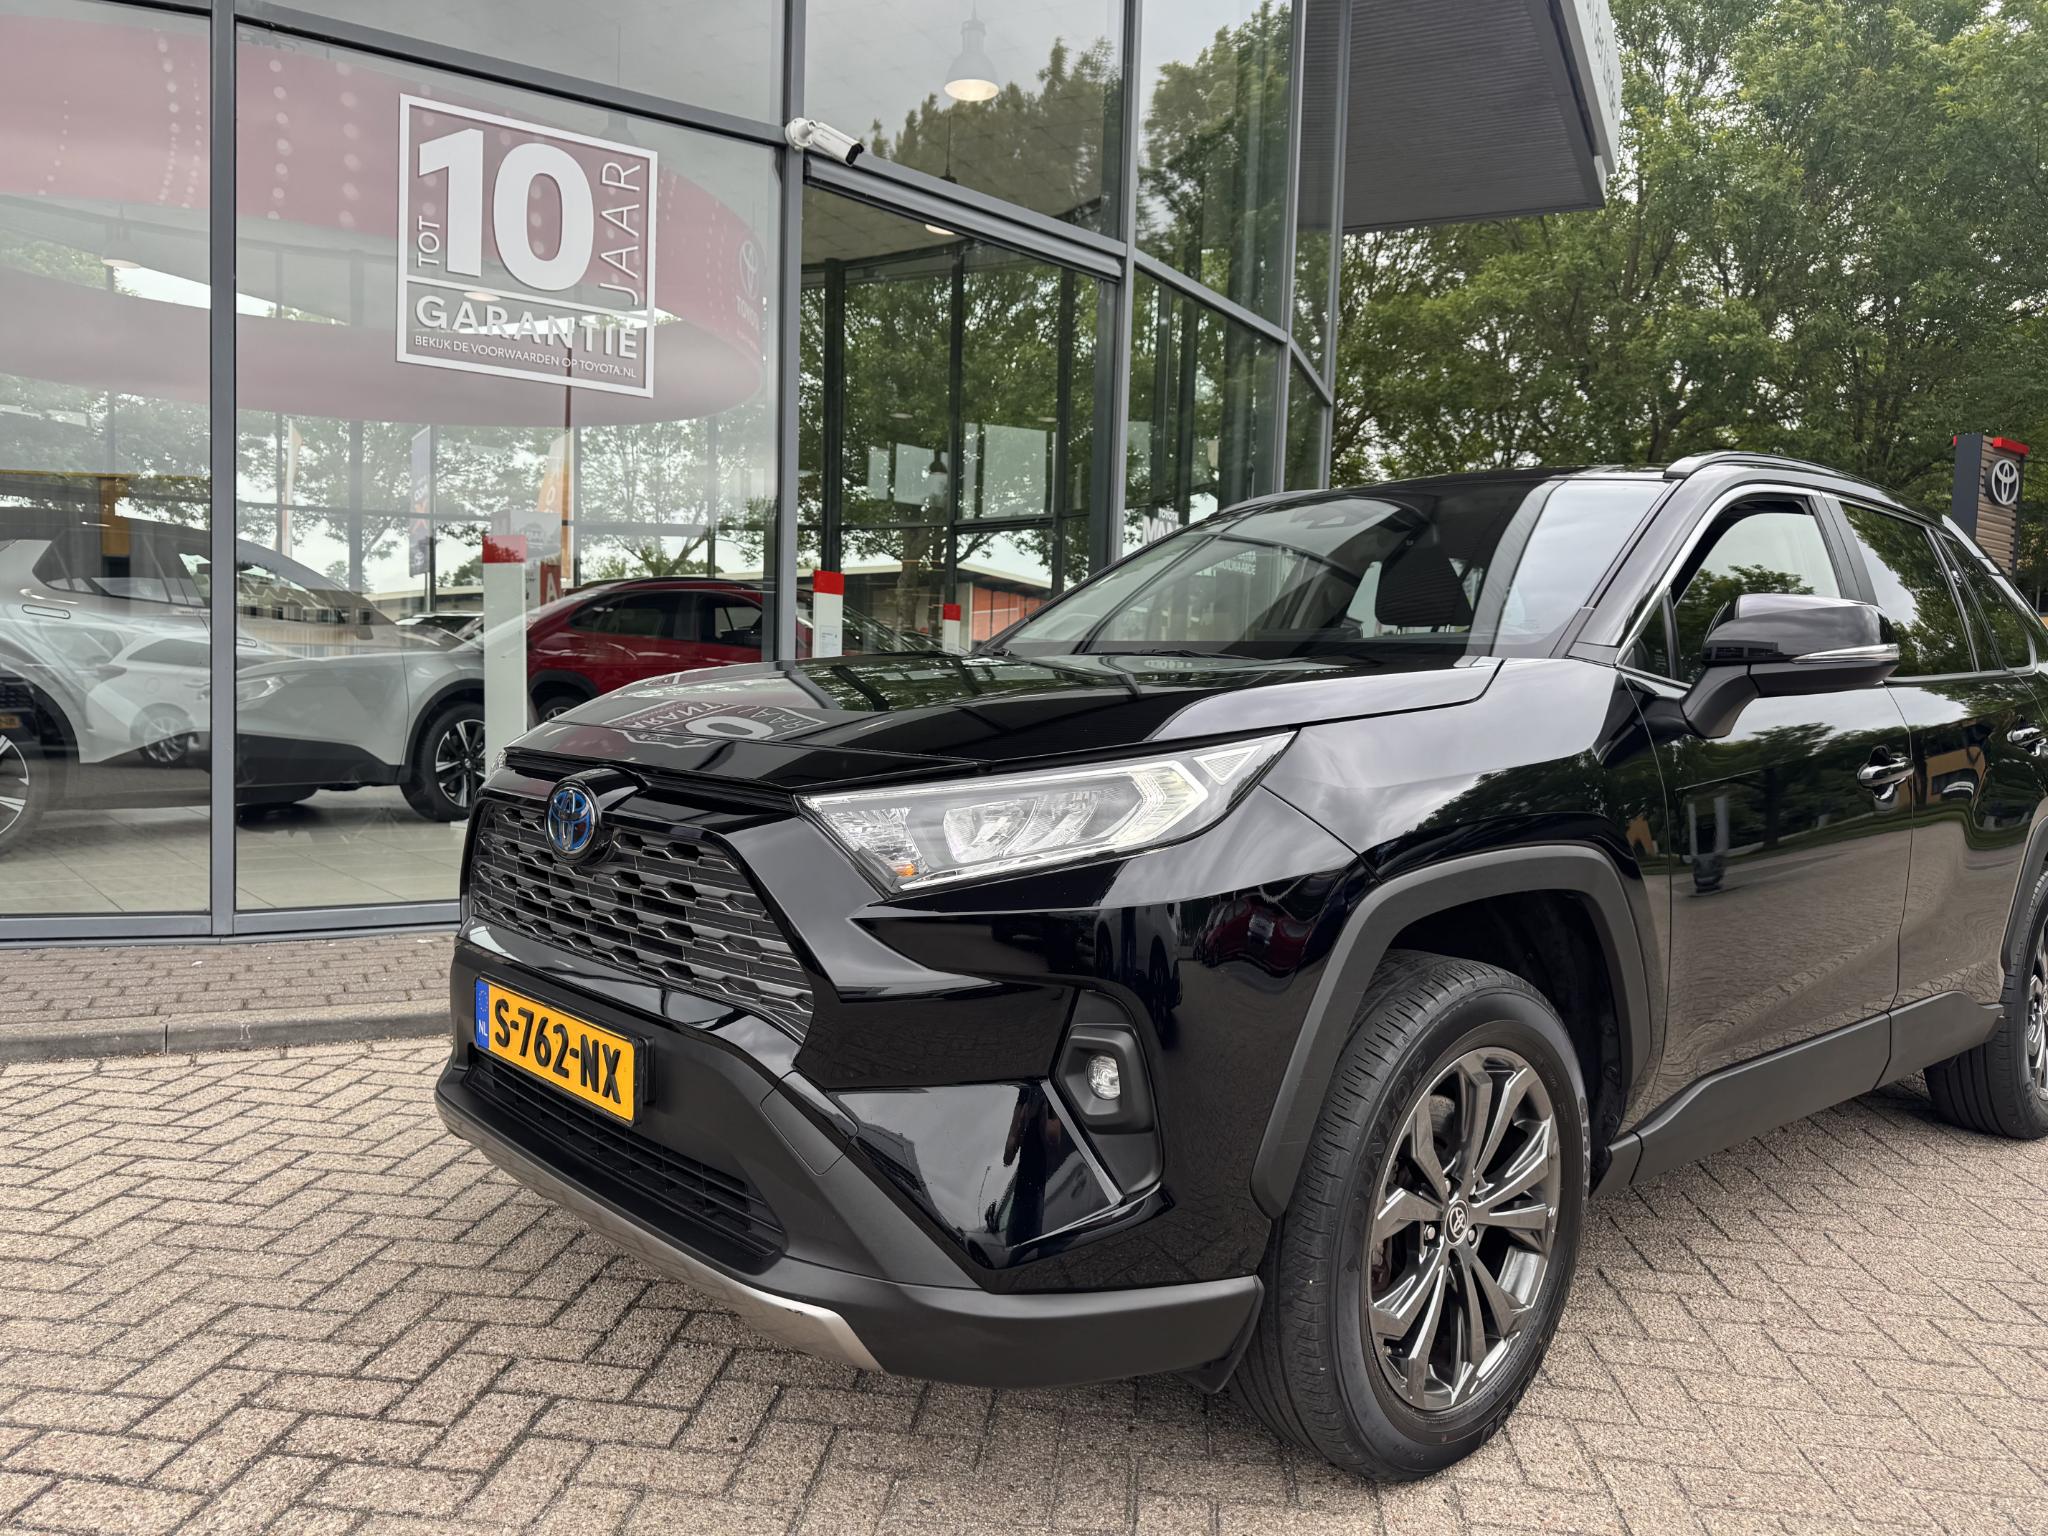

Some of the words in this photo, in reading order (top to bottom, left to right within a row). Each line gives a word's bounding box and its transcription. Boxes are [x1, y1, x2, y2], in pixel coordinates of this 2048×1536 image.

[417, 215, 440, 267] TOT
[418, 128, 595, 291] 10
[599, 161, 641, 305] JAAR
[415, 295, 638, 359] GARANTIE
[415, 335, 451, 350] BEKIJK
[453, 341, 469, 353] DE
[470, 343, 559, 366] VOORWAARDEN
[561, 357, 577, 369] OP
[579, 360, 637, 378] TOYOTA.NL
[478, 1021, 488, 1037] NL
[494, 998, 622, 1105] S-762-NX
